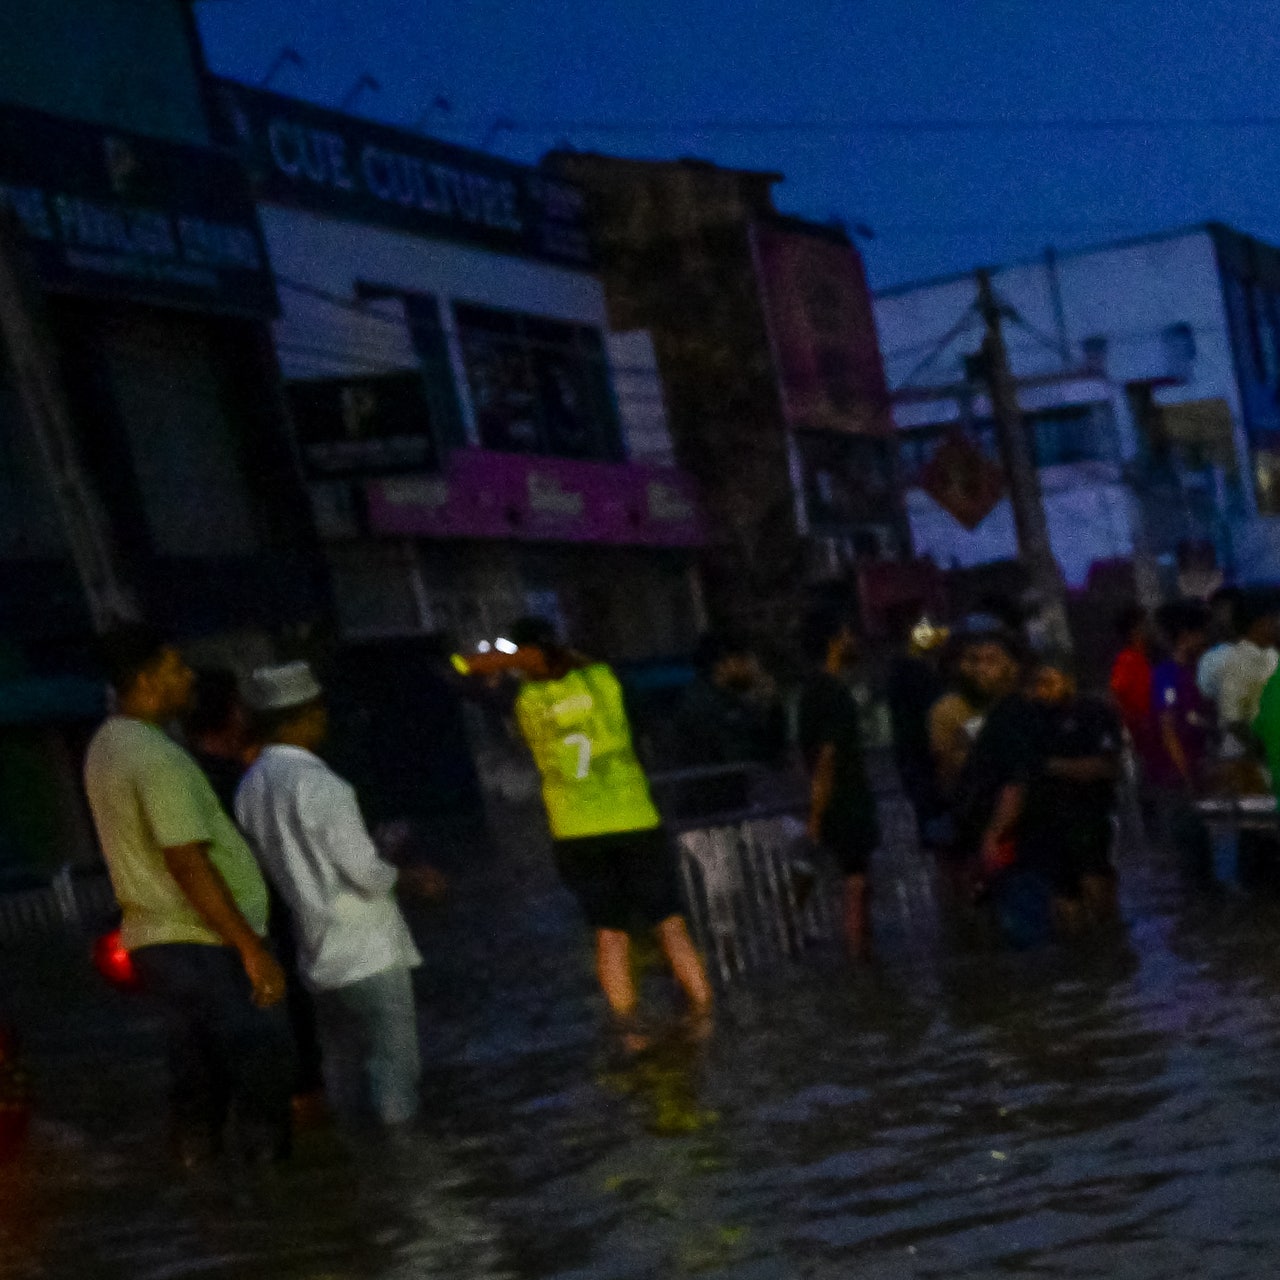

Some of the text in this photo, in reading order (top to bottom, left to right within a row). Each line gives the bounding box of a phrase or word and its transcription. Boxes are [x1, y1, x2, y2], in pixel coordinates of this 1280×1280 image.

[267, 118, 354, 190] CUE
[361, 143, 524, 233] CULTURE
[562, 732, 593, 781] 7
